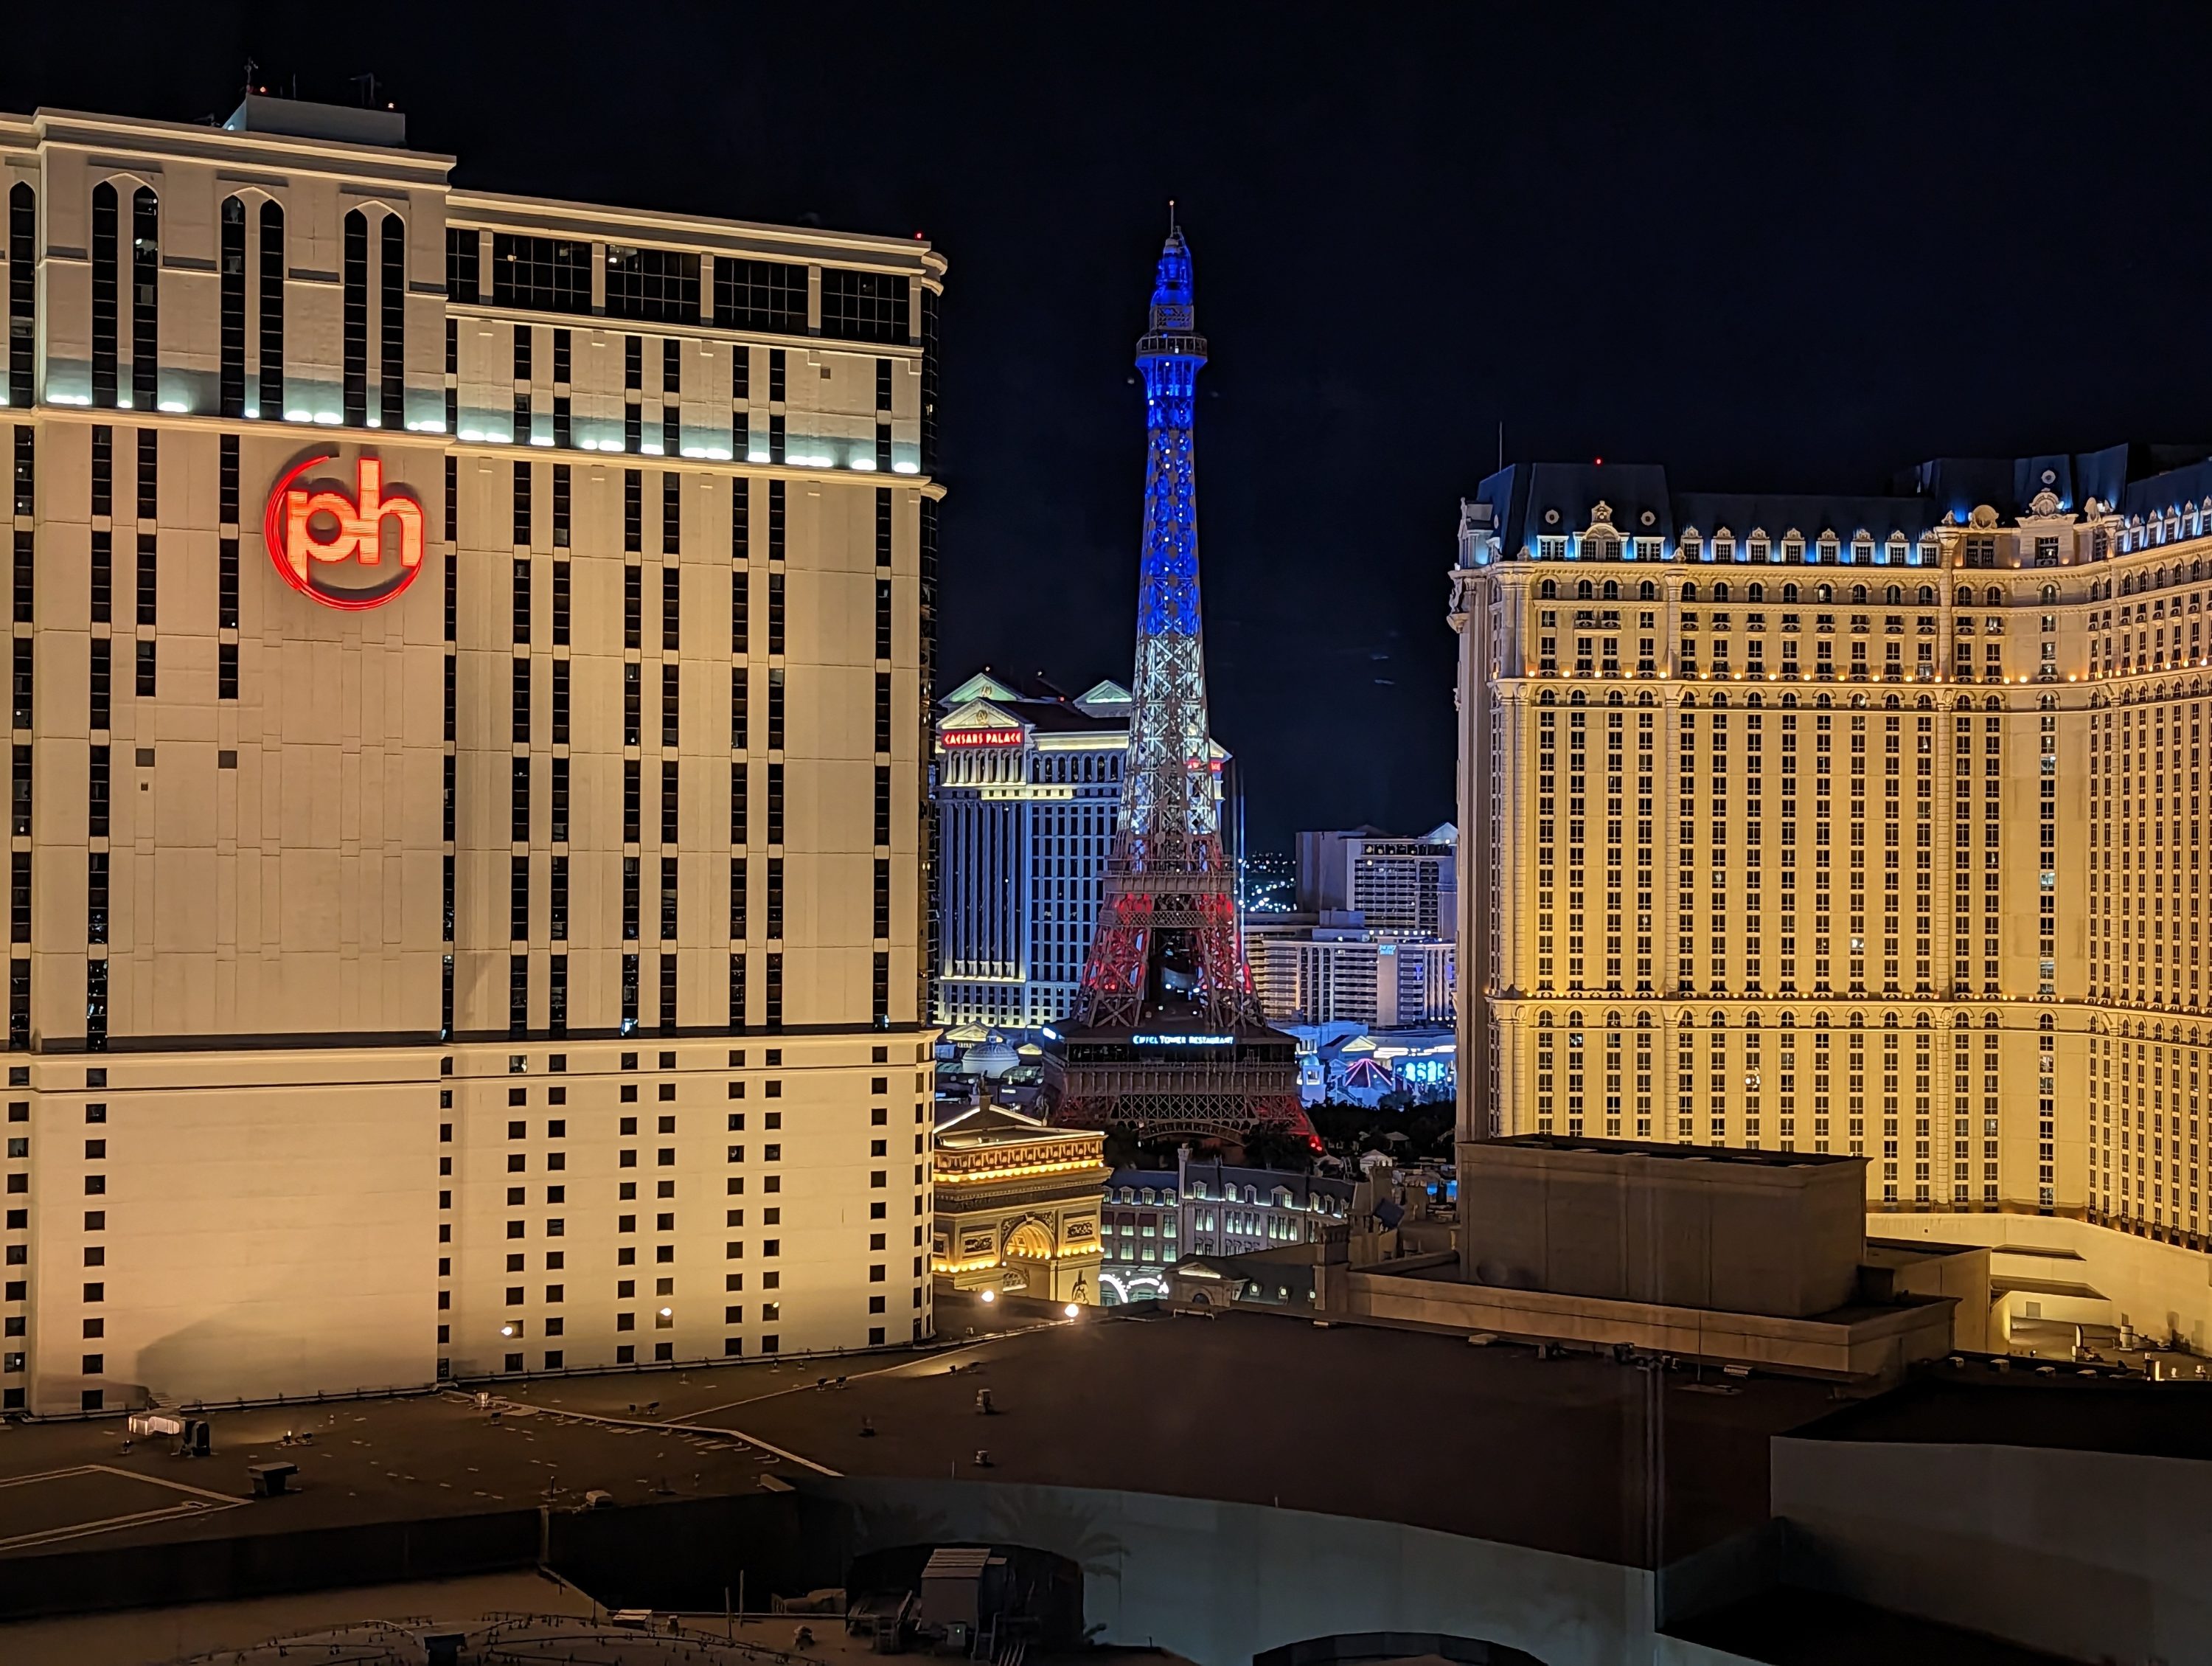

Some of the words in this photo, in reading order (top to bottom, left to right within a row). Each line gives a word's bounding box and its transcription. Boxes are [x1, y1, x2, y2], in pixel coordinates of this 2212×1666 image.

[287, 457, 424, 585] ph
[944, 732, 984, 745] CAESARS
[986, 732, 1021, 743] PALACE
